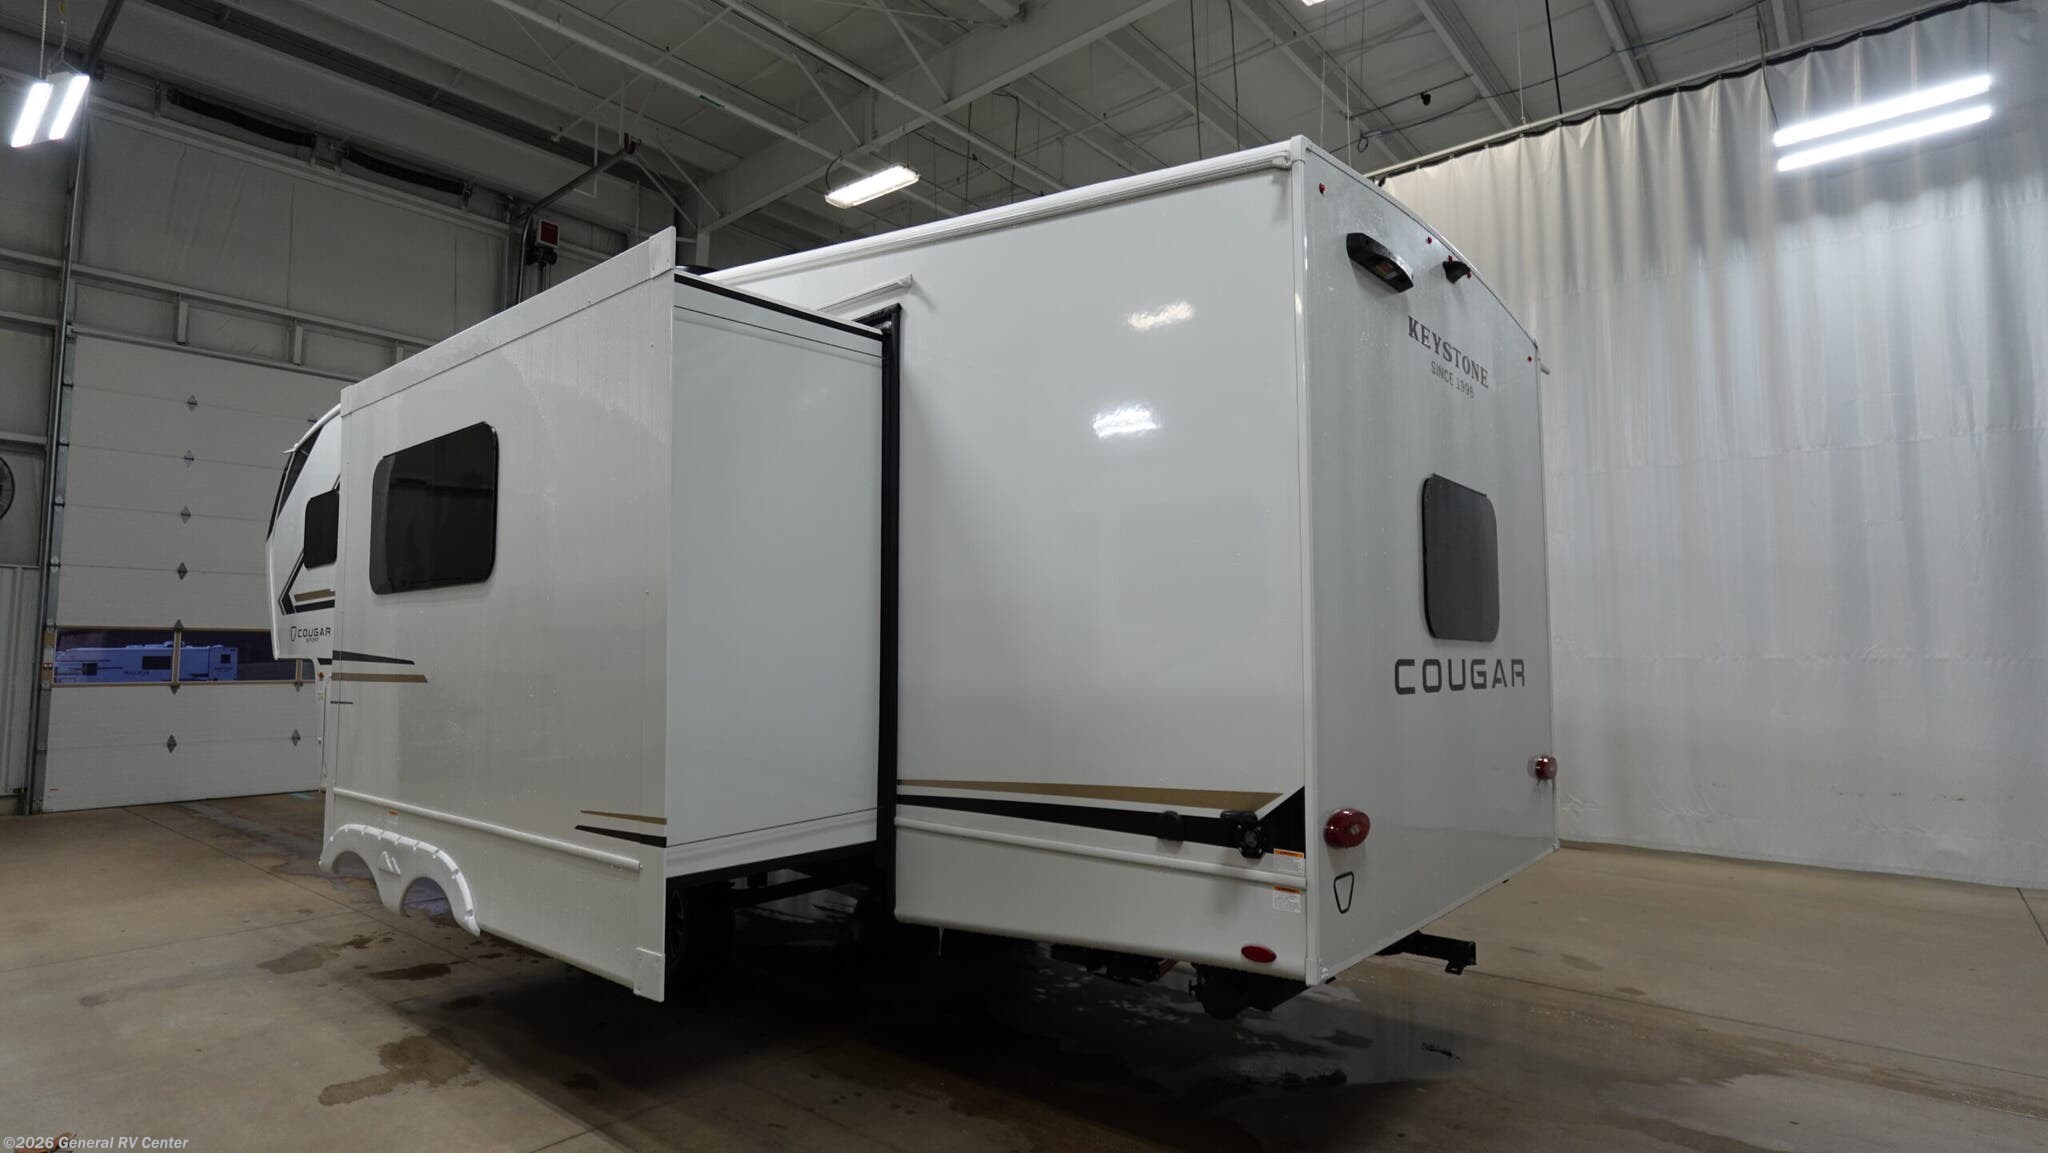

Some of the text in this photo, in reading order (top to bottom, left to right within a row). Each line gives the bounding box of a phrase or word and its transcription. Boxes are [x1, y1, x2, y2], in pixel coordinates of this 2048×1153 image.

[1408, 315, 1489, 389] KEYSTONE
[1431, 360, 1454, 386] SINCE
[297, 627, 331, 638] COUGAR
[1394, 658, 1525, 695] COUGAR
